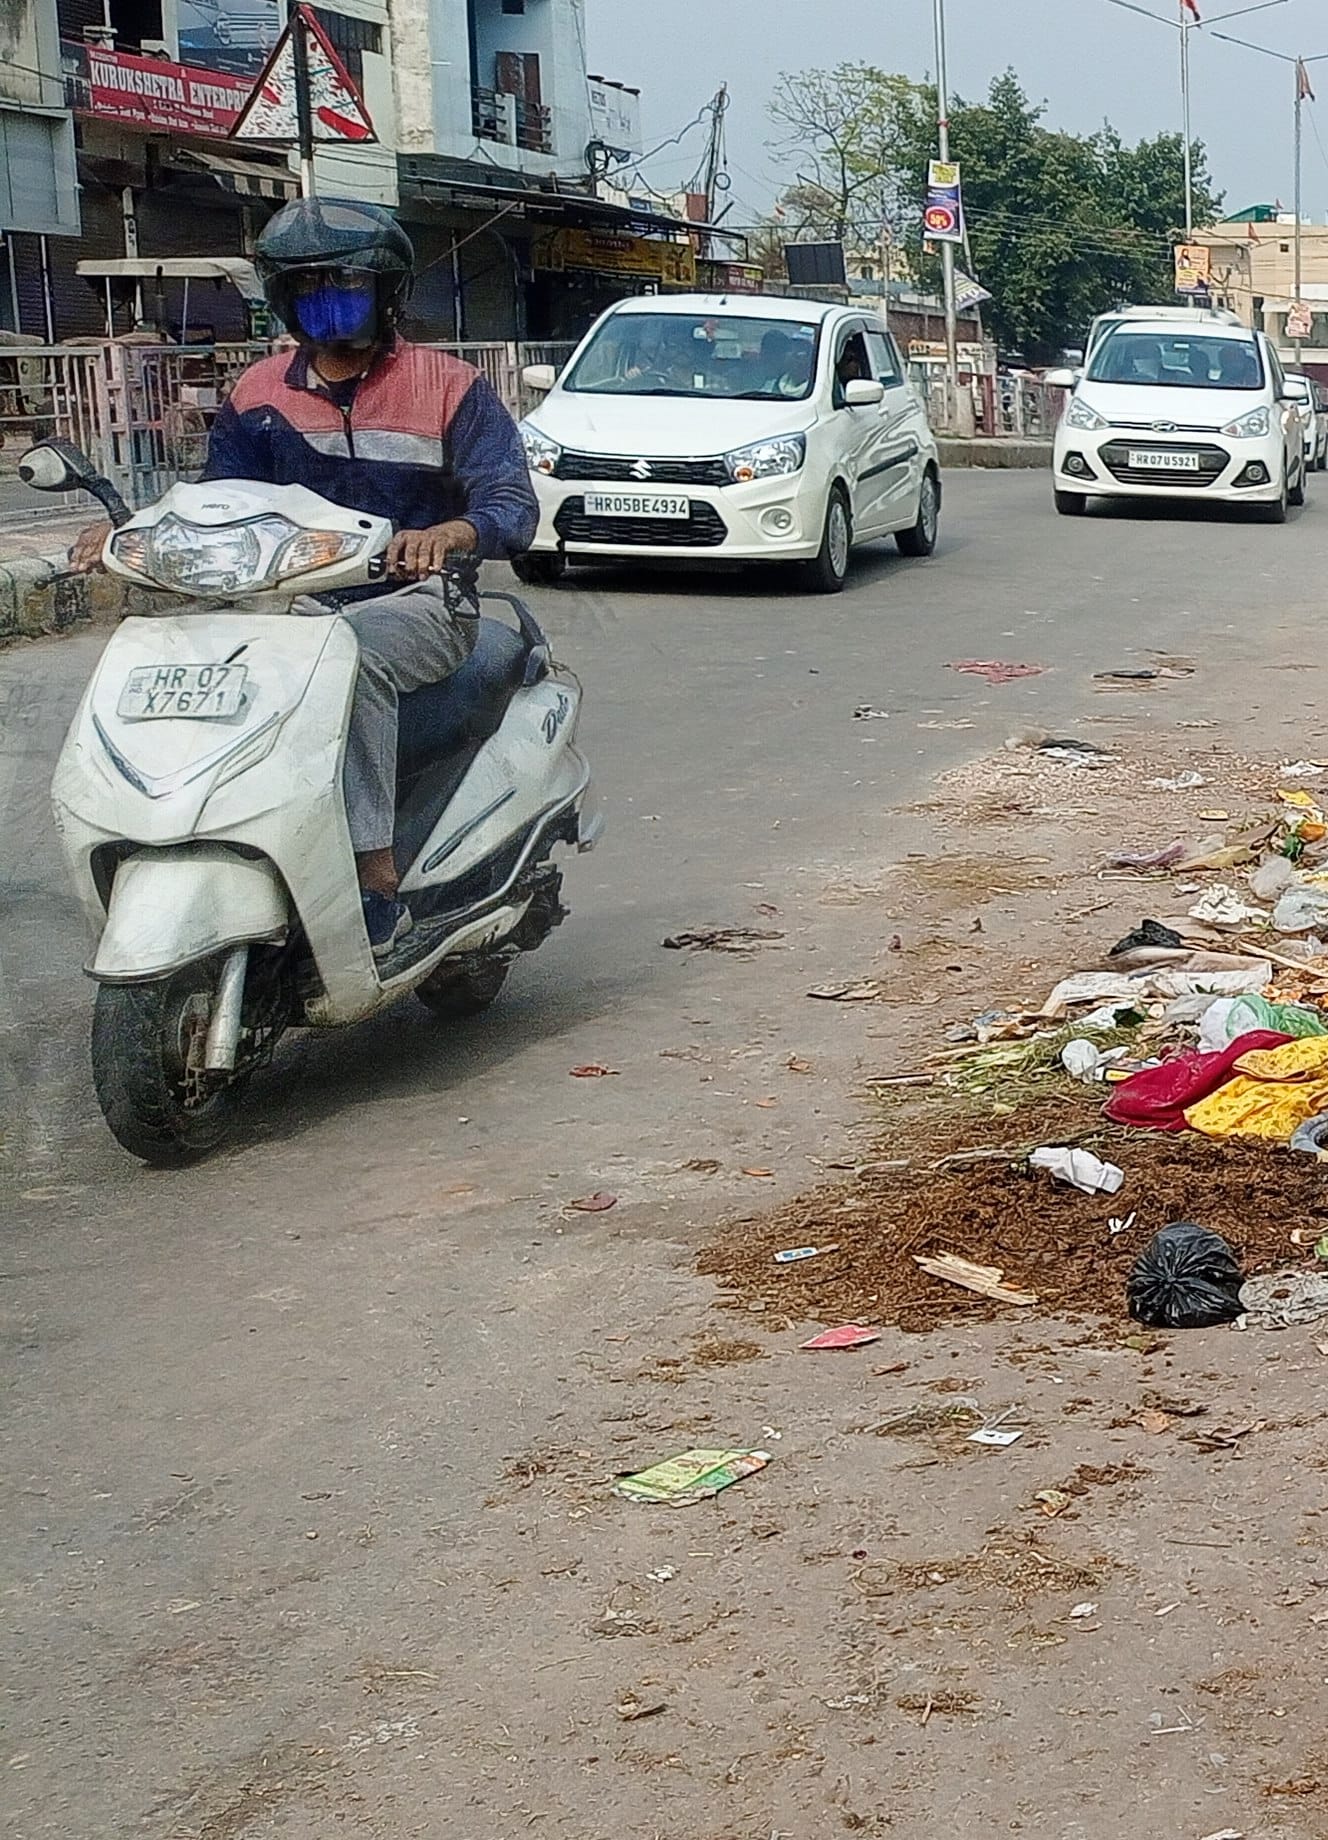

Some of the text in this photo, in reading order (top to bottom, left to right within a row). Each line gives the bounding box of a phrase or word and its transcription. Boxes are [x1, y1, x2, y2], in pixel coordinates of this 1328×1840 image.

[90, 60, 186, 103] KURUKSHETRA
[594, 496, 687, 514] HR05BE4934
[154, 667, 231, 689] HR 07
[142, 690, 226, 714] X7671
